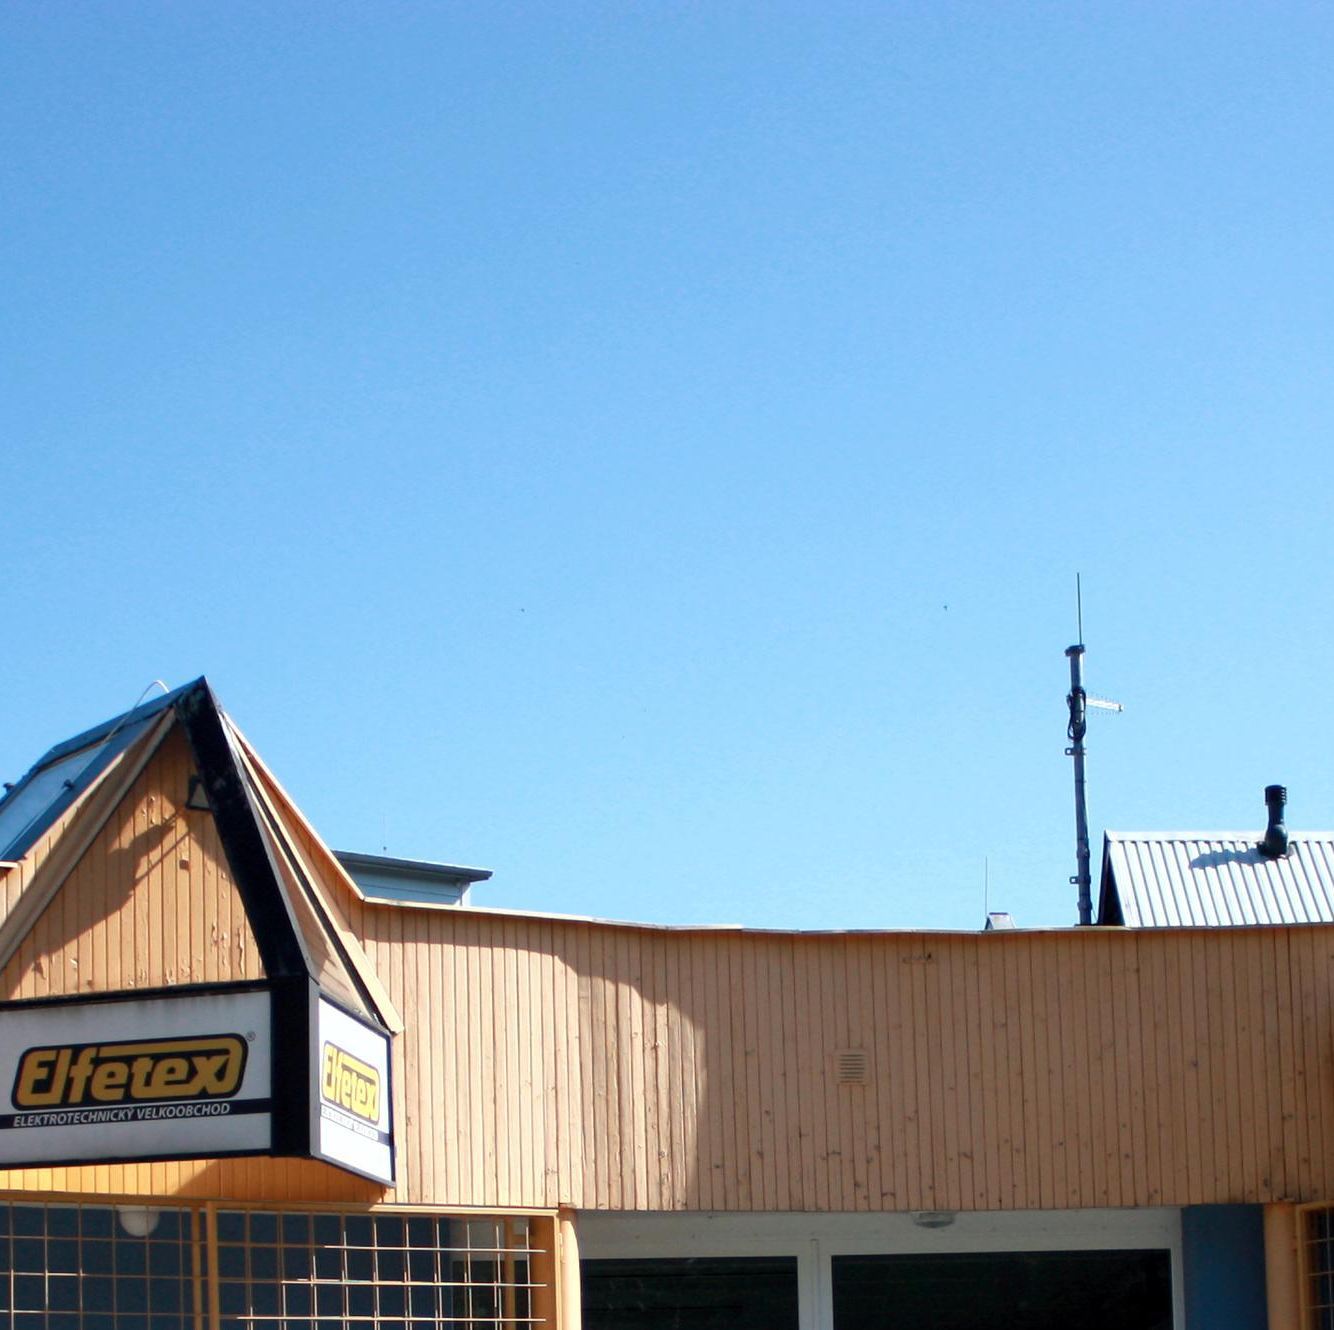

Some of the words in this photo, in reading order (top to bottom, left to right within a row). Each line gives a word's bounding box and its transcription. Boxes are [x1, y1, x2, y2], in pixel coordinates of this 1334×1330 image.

[15, 1036, 244, 1108] Elfetex
[322, 1041, 380, 1123] Elfetex
[12, 1106, 135, 1128] ELEKTROTECHNICKÝ
[136, 1103, 231, 1120] VELKOOBCHOD
